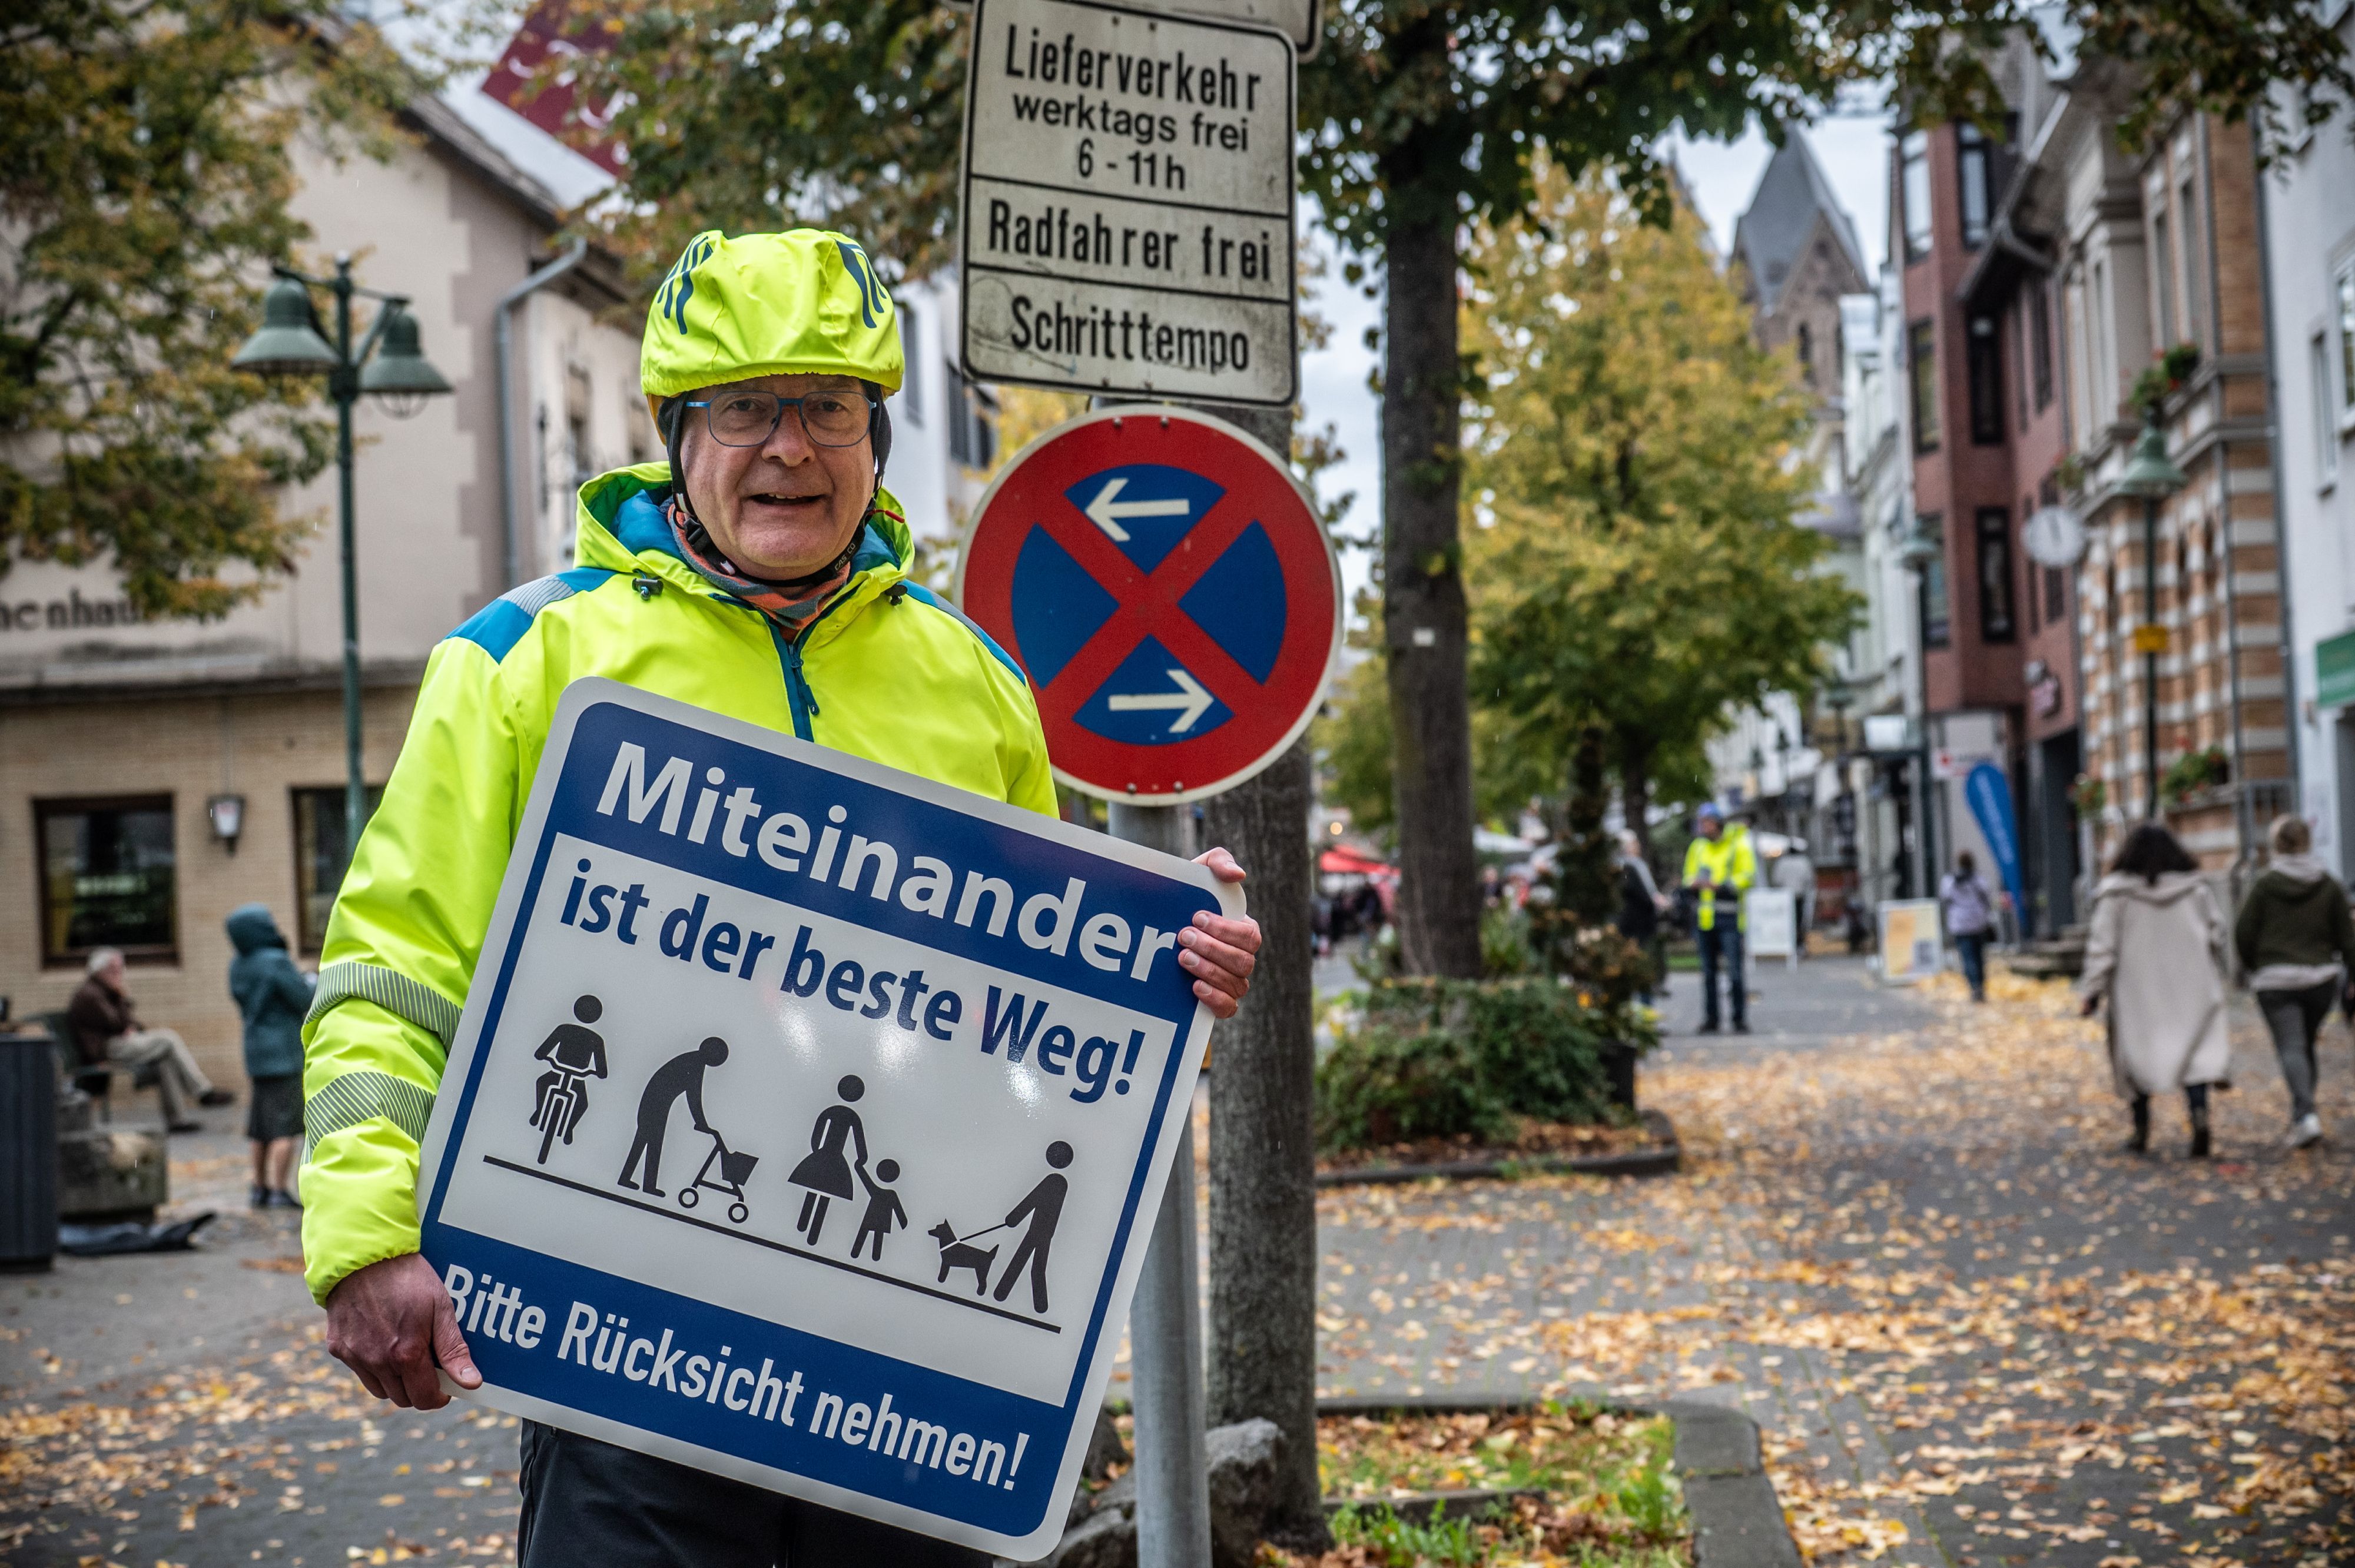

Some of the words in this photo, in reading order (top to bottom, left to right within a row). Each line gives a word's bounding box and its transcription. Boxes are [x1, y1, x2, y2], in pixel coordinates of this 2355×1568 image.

[1005, 23, 1261, 112] Lieferverkehr
[1013, 93, 1177, 146] werktags
[1191, 111, 1248, 152] frei
[989, 198, 1179, 271] Radfahrer
[1201, 225, 1271, 281] frei
[1008, 294, 1249, 374] Schritttempo
[596, 740, 1177, 982] Miteinander
[560, 858, 650, 945] ist
[659, 893, 775, 981] der
[780, 924, 963, 1041] beste
[980, 984, 1146, 1104] Weg!
[444, 1263, 546, 1349] Bitte
[557, 1300, 804, 1427] Rücksicht
[808, 1391, 1030, 1491] nehmen!
